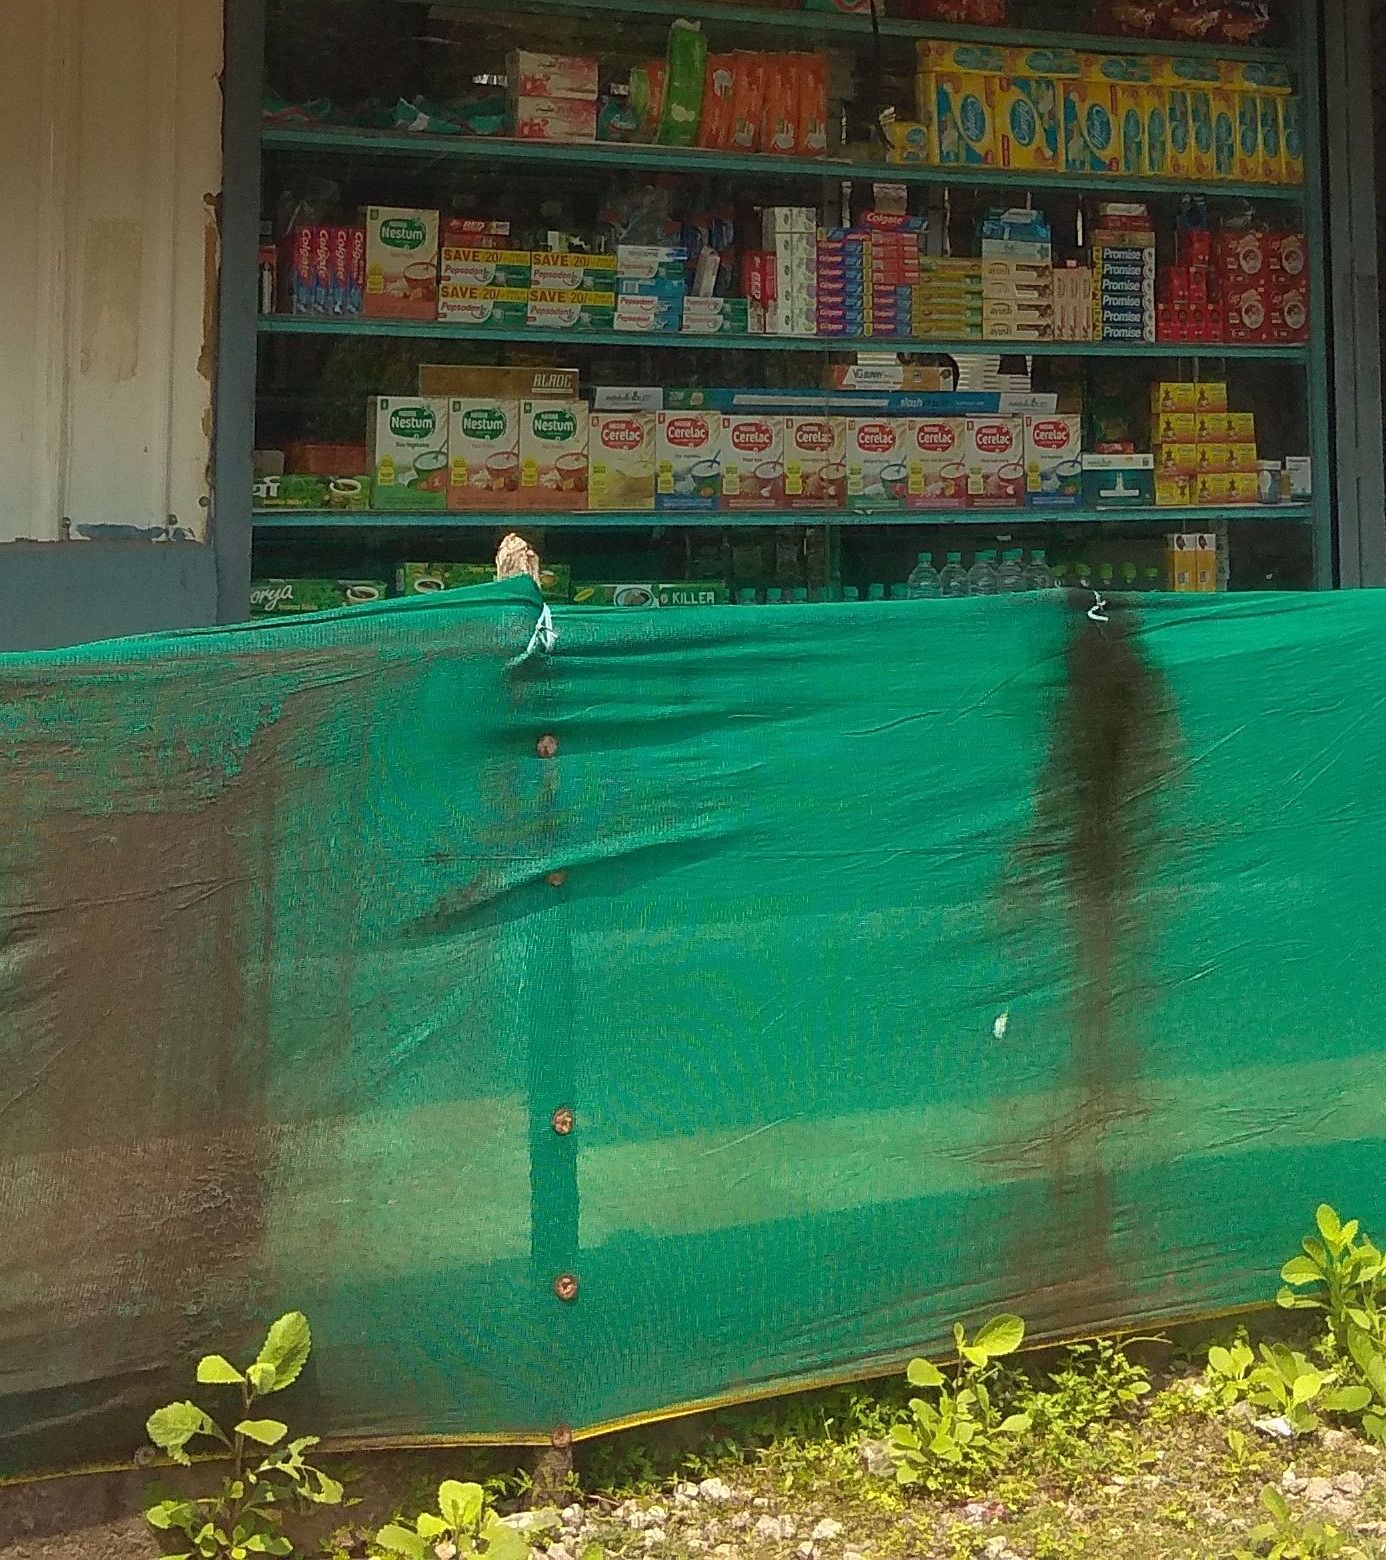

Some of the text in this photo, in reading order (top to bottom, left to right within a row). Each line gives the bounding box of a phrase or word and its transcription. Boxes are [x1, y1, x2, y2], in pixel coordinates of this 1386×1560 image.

[866, 212, 903, 225] Colgate
[381, 225, 423, 241] Nestum
[299, 229, 312, 279] Colgate
[315, 228, 329, 279] Colgate
[333, 230, 347, 280] Colgate
[443, 249, 480, 262] SAVE
[1103, 247, 1142, 260] Promise
[532, 254, 568, 267] SAVE
[444, 264, 489, 277] Pepsodent
[1103, 263, 1141, 276] Promise
[1102, 278, 1140, 292] Promise
[440, 286, 478, 299] SAVE
[530, 290, 566, 303] SAVE
[440, 301, 485, 314] Pepsodent
[1102, 294, 1141, 308] Promise
[1103, 310, 1141, 323] Promise
[1102, 326, 1141, 339] Promise
[391, 416, 433, 429] Nestum
[463, 418, 504, 431] Nestum
[533, 419, 575, 432] Nestum
[602, 429, 641, 441] Cerelac
[667, 427, 706, 439] Cerelac
[733, 431, 770, 443] Cerelac
[796, 431, 833, 444] Cerelac
[858, 431, 893, 445] Cerelac
[918, 431, 953, 445] Cerelac
[976, 433, 1011, 446] Cerelac
[1034, 429, 1068, 442] Cerelac
[671, 591, 715, 606] KILLER
